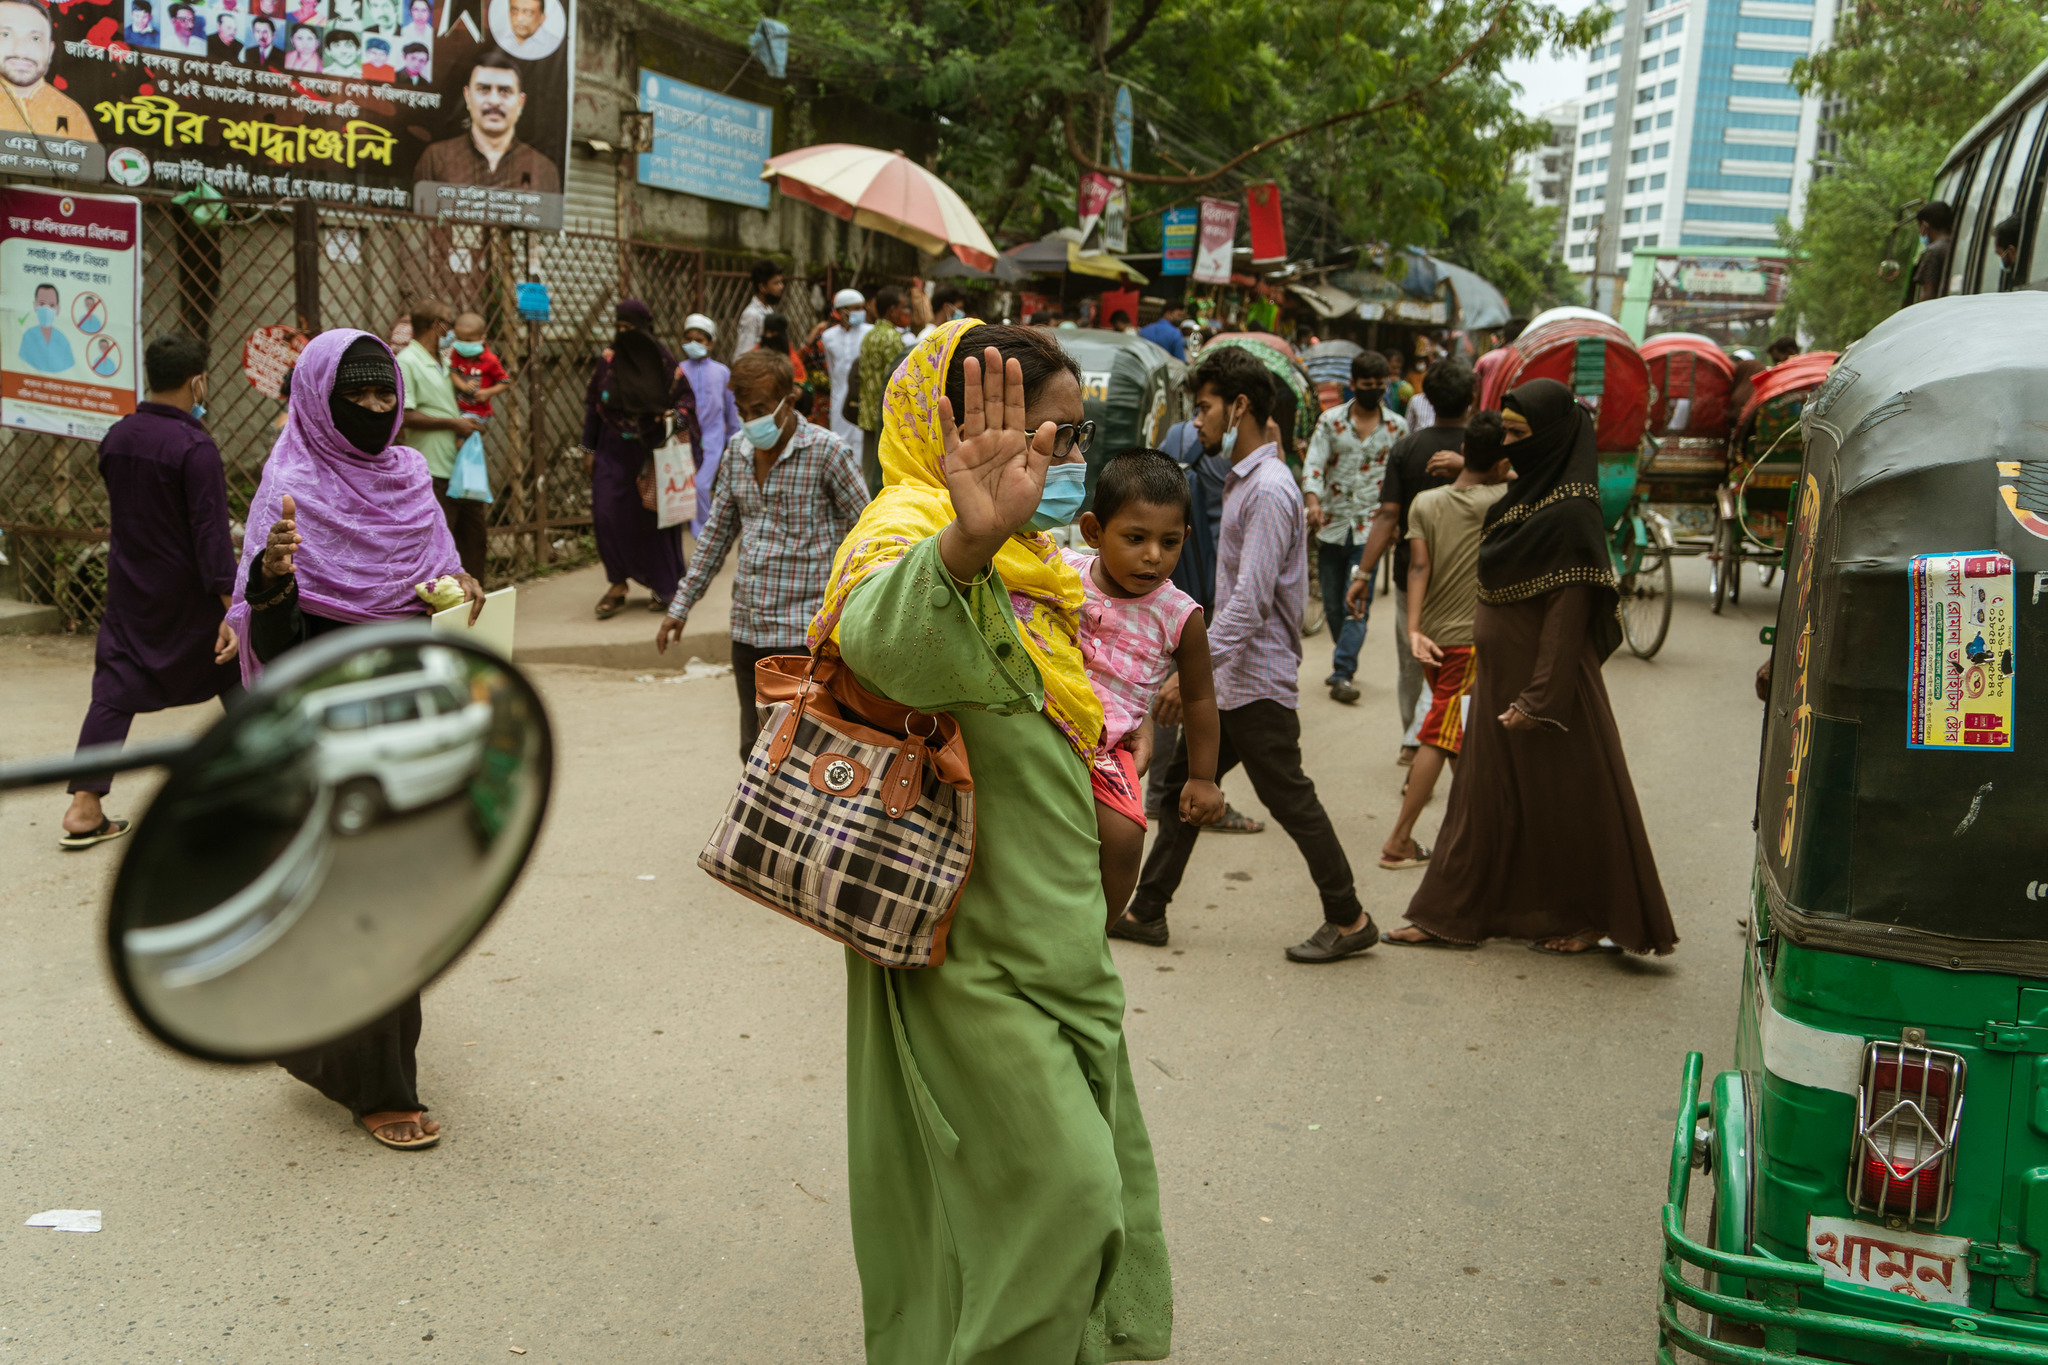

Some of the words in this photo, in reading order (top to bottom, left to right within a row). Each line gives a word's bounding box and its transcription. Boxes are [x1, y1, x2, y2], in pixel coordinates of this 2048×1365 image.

[64, 39, 105, 61] জাতির
[108, 43, 139, 66] পিতা
[141, 52, 181, 77] বঙ্গবন্ধু
[183, 59, 210, 77] শেখ
[211, 61, 252, 85] মুজিবুর
[345, 81, 370, 99] শেখ
[157, 79, 170, 93] ও
[173, 78, 201, 100] ১৫ই
[202, 84, 256, 105] আগস্টের
[257, 92, 289, 110] সকল
[334, 100, 361, 118] প্রতি
[4, 137, 39, 153] এম
[93, 95, 210, 147] গভীর
[218, 119, 398, 168] শ্রদ্ধাঞ্জলি
[8, 216, 31, 234] স্বাস্থ্য
[32, 217, 86, 238] অধিদপ্তরের
[88, 223, 129, 243] নির্দেশনা
[1946, 559, 1966, 599] মেসার্স
[1946, 601, 1963, 646] রোমানা
[1988, 608, 1997, 698] ০১৮৫৪-৬৫৮৪৭
[1997, 609, 2006, 698] ০১৭১৬-৪৮৪৮৬
[1945, 648, 1965, 712] ভ্যারাইটিস
[1815, 1231, 1957, 1302] থামুন
